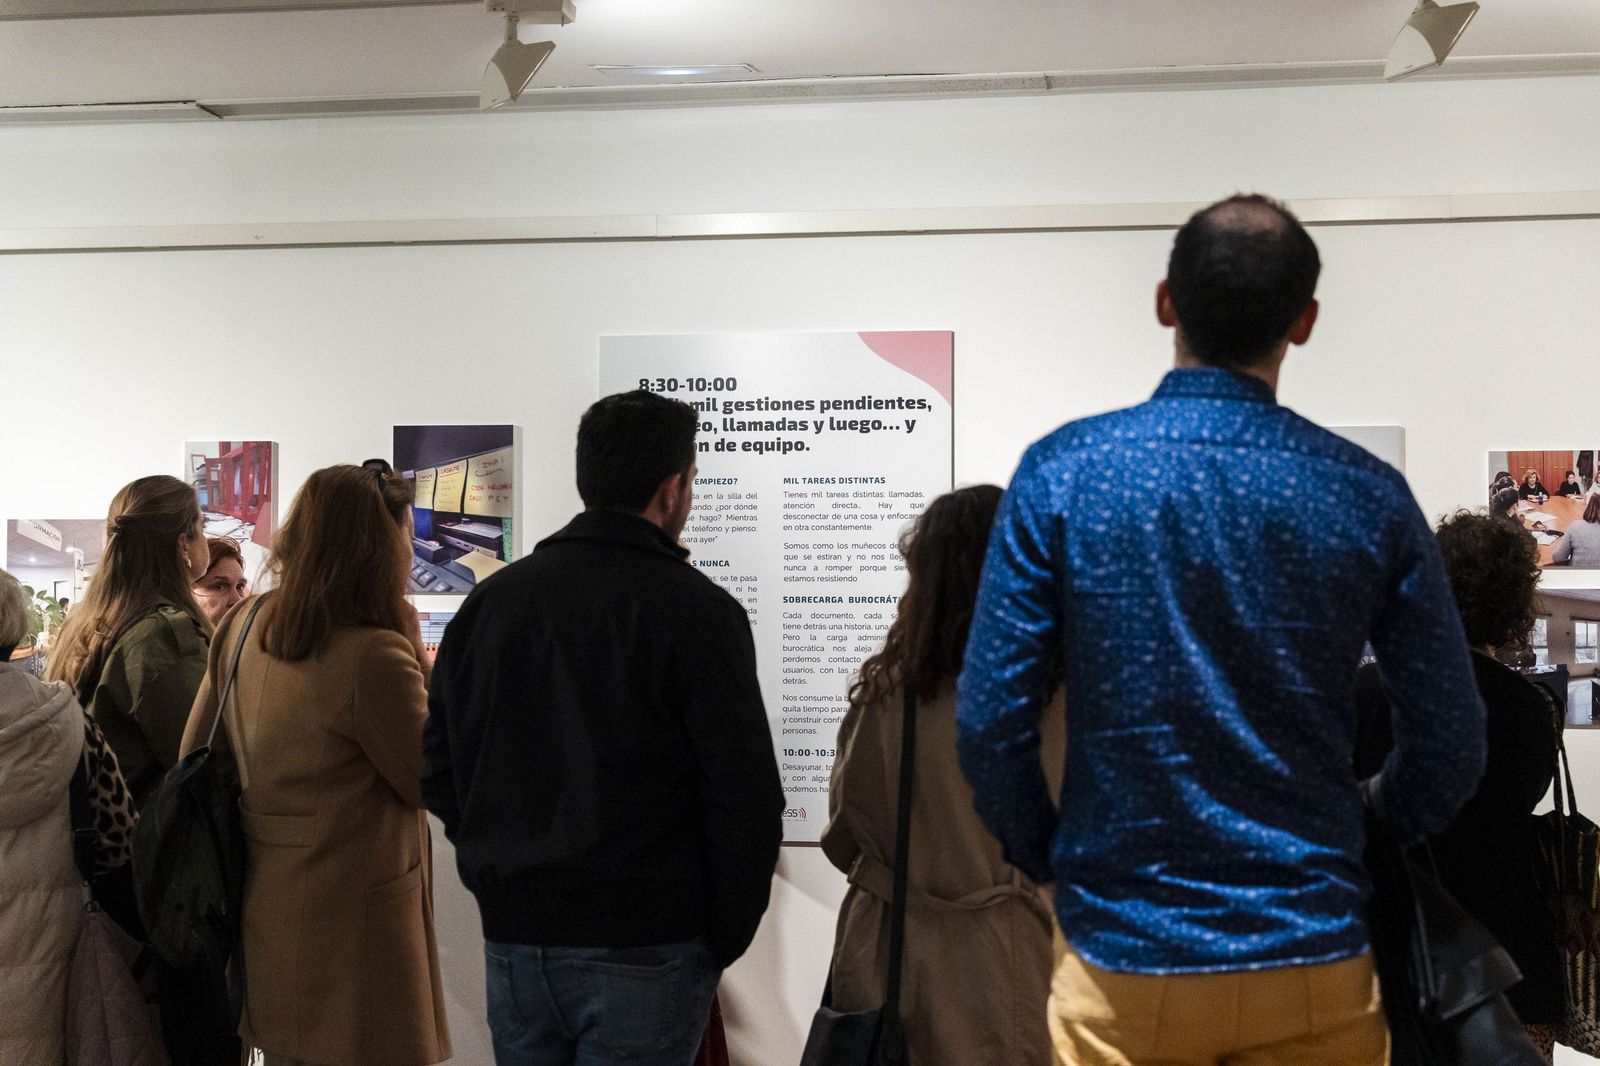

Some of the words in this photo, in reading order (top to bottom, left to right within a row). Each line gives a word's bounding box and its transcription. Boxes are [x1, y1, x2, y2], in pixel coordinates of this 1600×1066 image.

[638, 377, 738, 393] 8:30-10:00
[690, 397, 718, 411] mil
[722, 397, 815, 415] gestiones
[820, 395, 931, 414] pendientes,
[723, 417, 808, 432] llamadas
[813, 420, 824, 434] y
[905, 420, 916, 433] y
[714, 438, 736, 452] de
[742, 437, 810, 455] equipo.
[878, 502, 893, 510] Hay
[700, 514, 721, 523] hago?
[732, 525, 757, 533] pienso:
[890, 552, 903, 561] lleg
[854, 645, 872, 653] aleja
[783, 705, 801, 714] quita
[783, 763, 823, 772] Desayunar,
